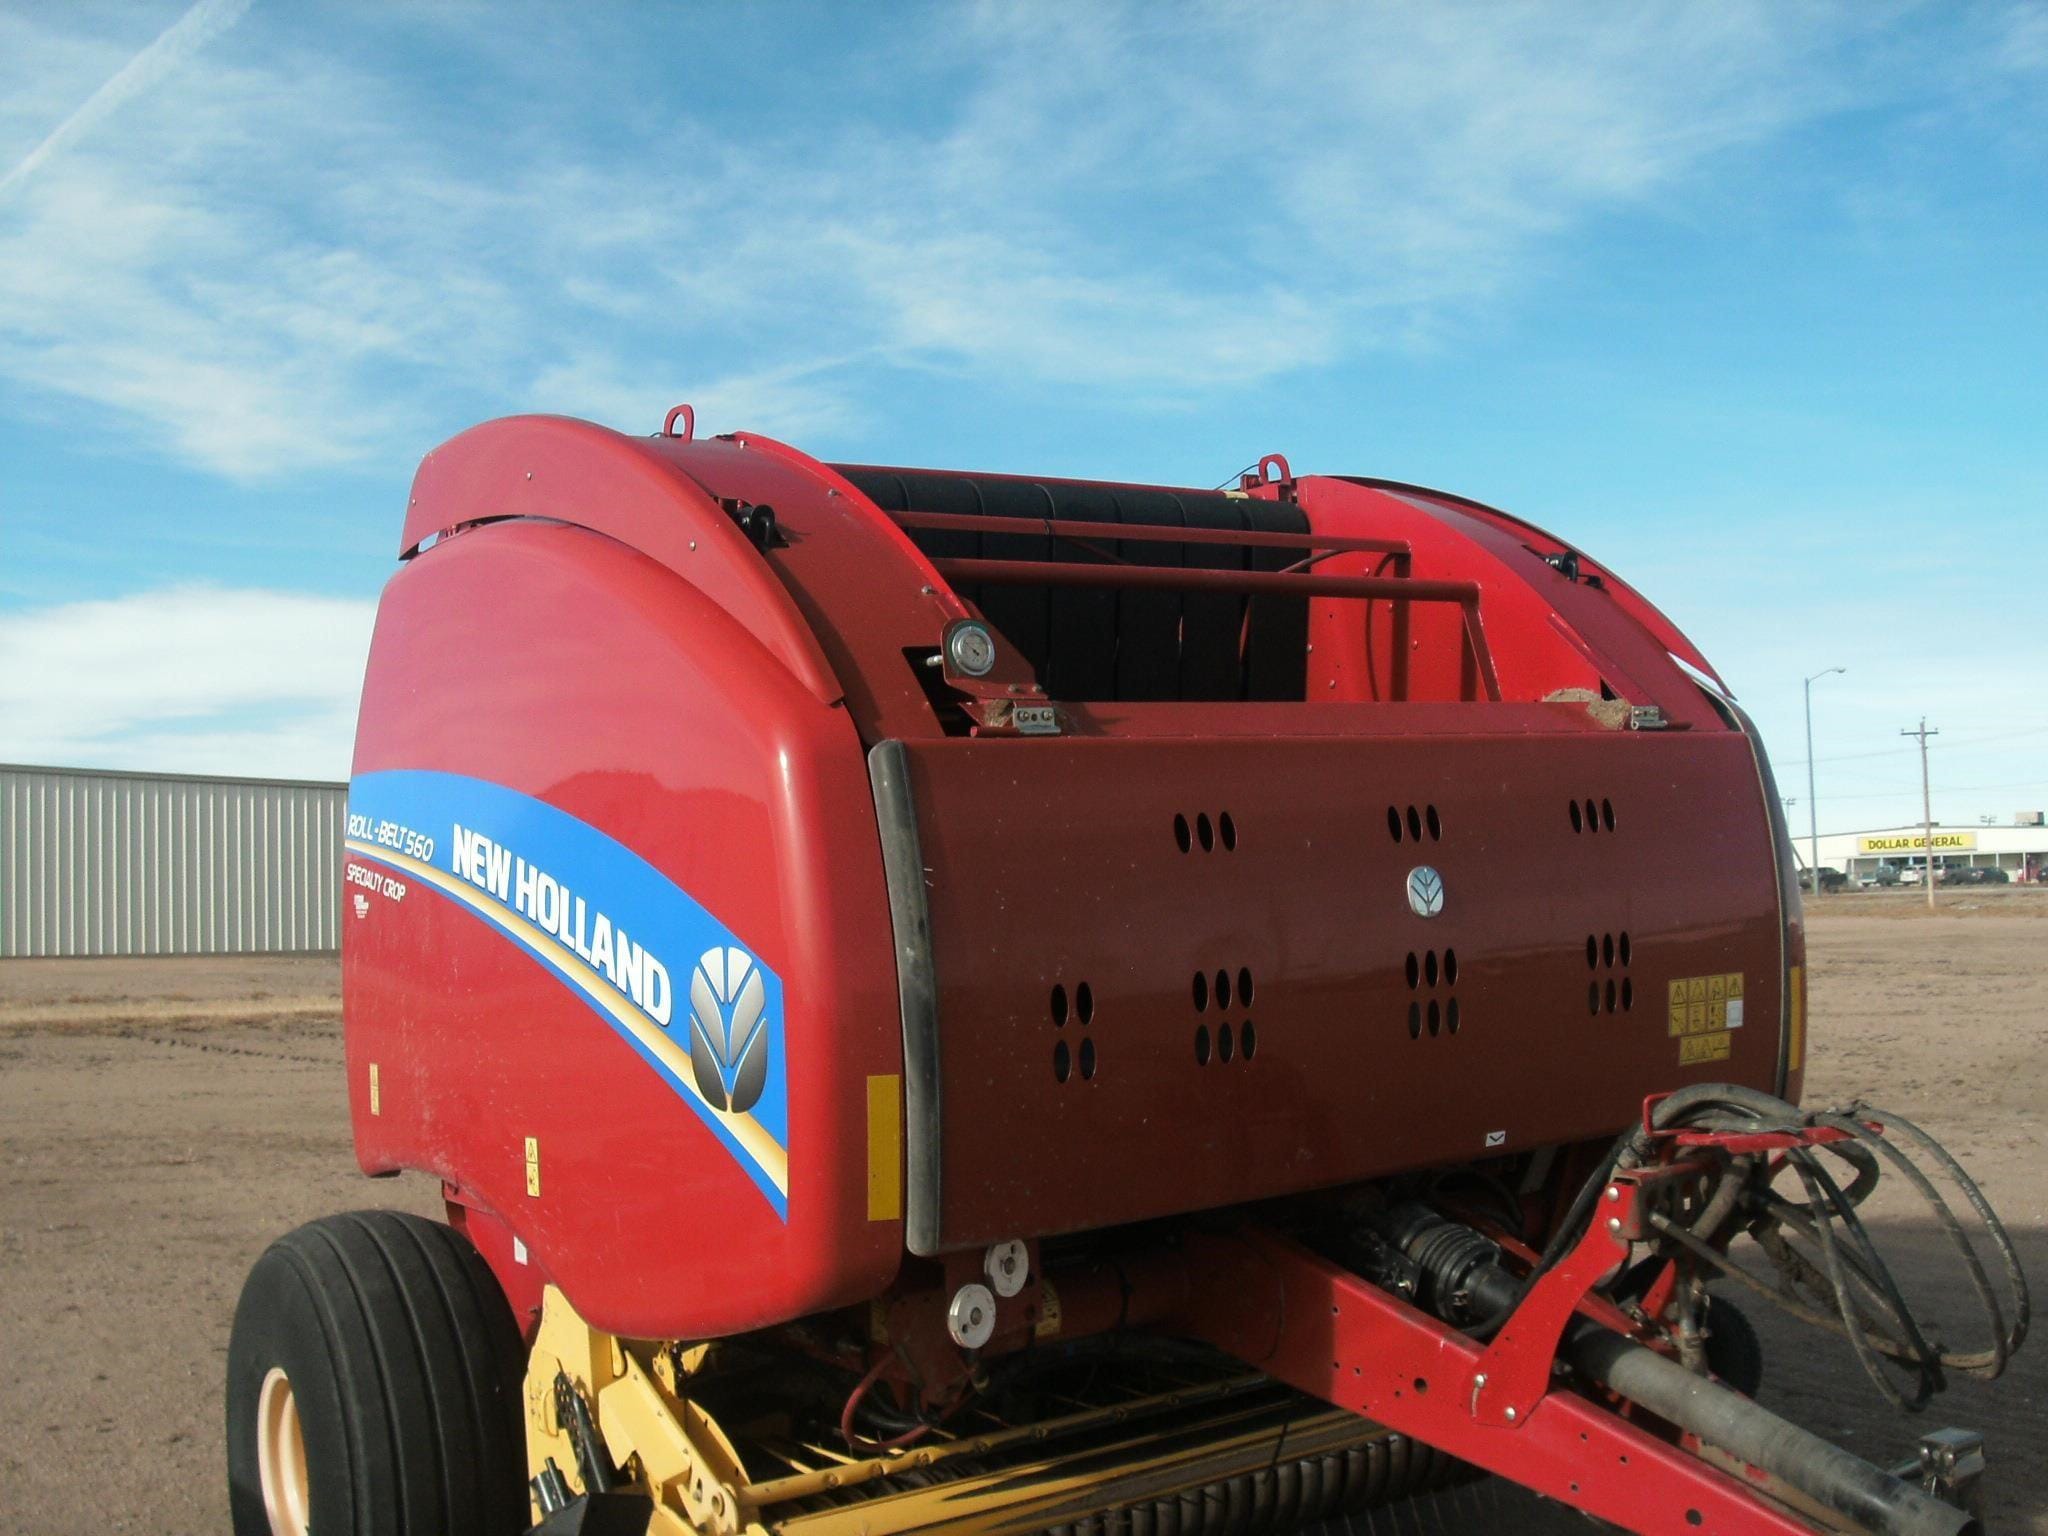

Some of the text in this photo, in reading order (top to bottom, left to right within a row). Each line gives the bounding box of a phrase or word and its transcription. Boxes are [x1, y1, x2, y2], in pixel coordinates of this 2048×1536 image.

[404, 830, 434, 862] 560
[1868, 839, 1909, 850] DOLLAR
[346, 863, 406, 902] SPECIALTY CROP
[452, 823, 673, 1027] NEW HOLLAND
